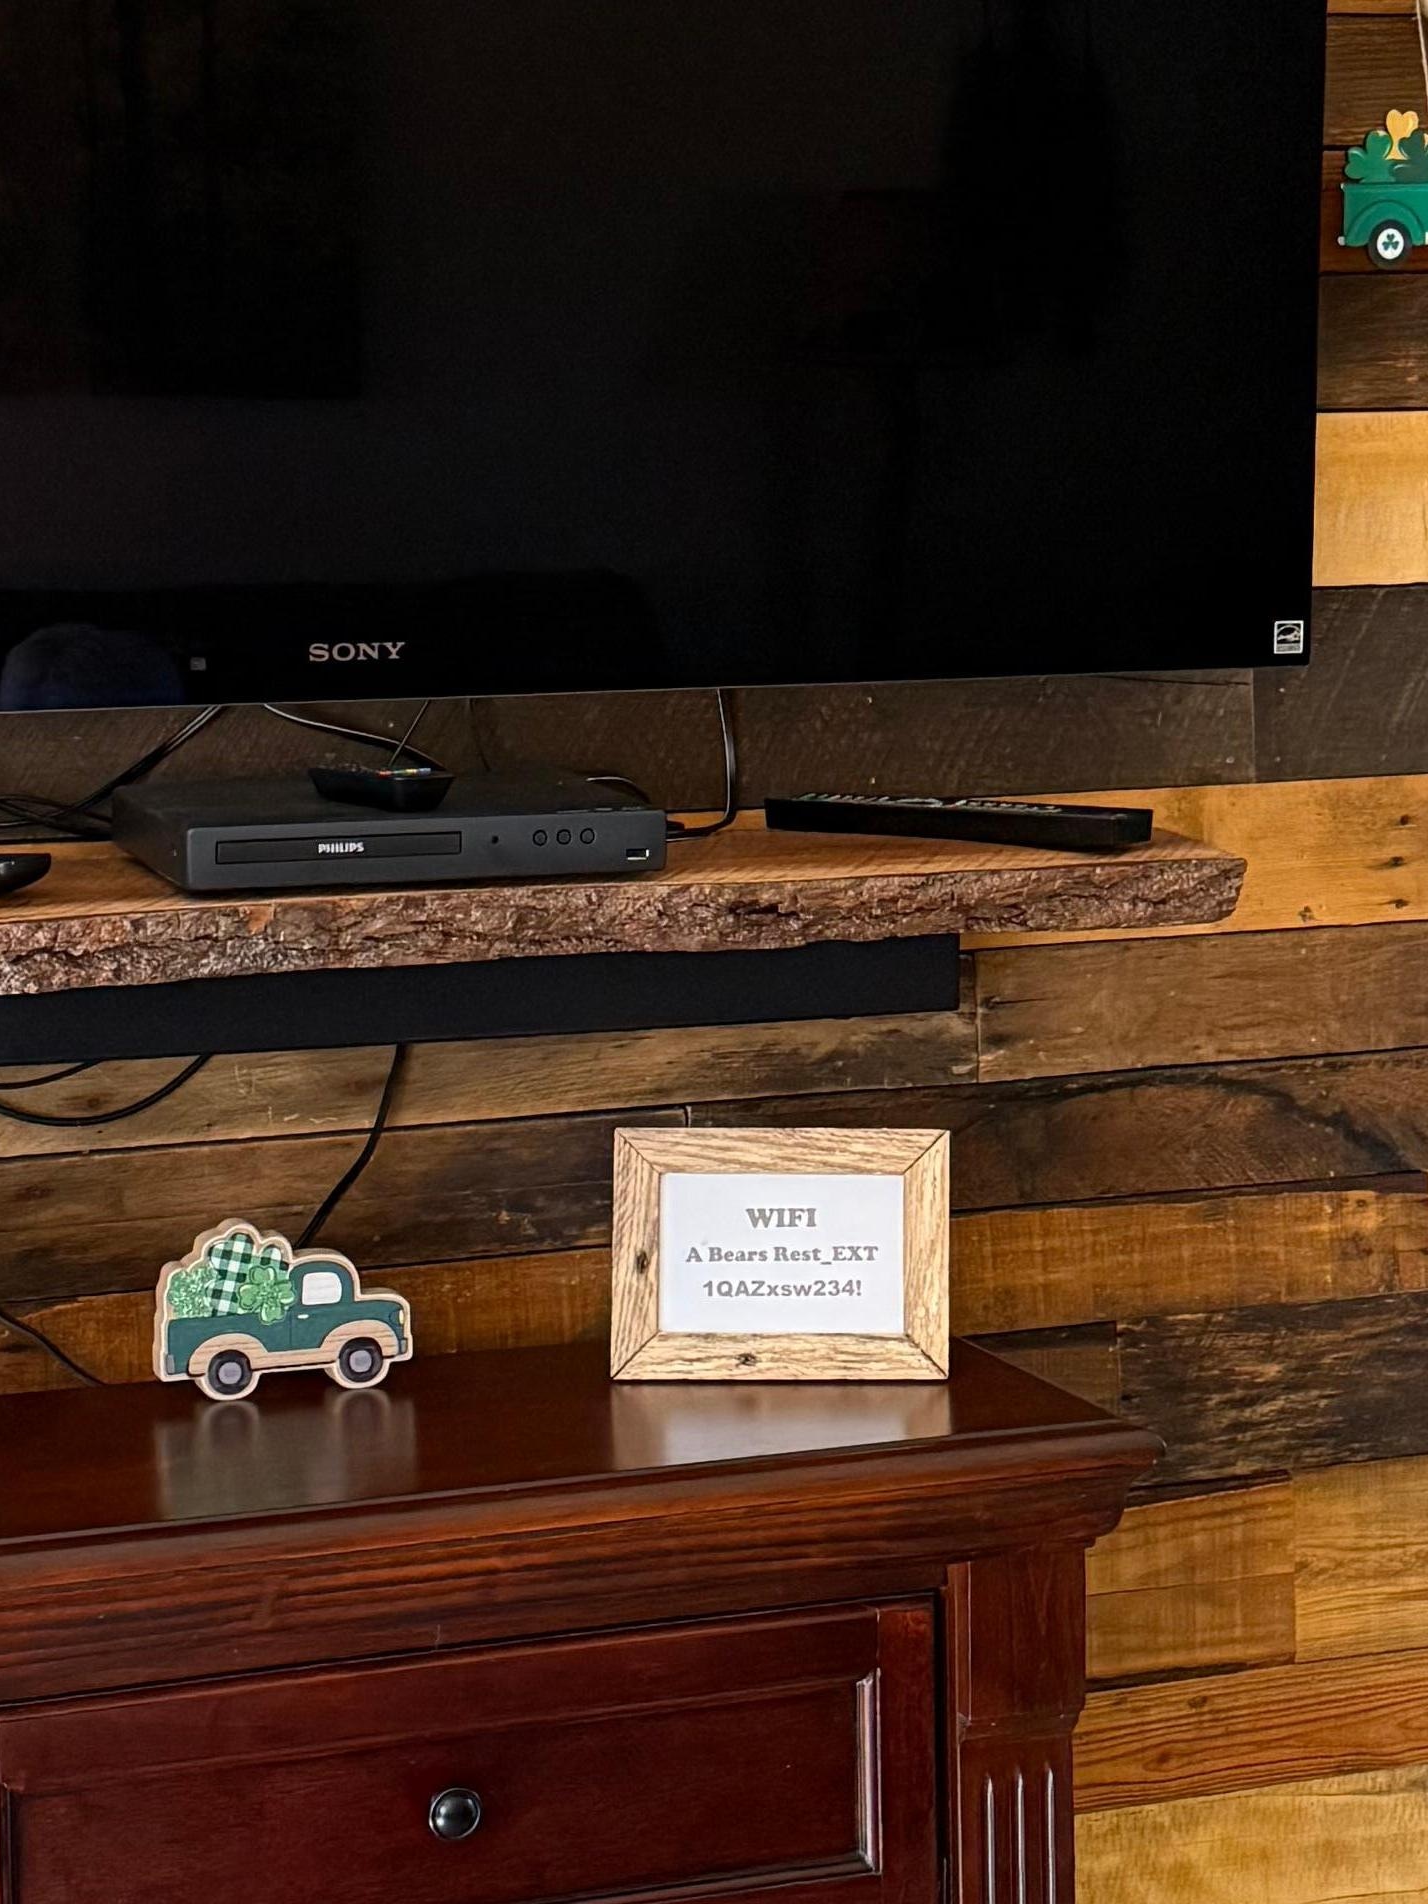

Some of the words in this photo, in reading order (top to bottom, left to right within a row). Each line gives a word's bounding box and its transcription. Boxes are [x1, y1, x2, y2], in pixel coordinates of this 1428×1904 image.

[308, 641, 406, 662] SONY
[318, 841, 365, 854] PHILIPS
[745, 1207, 817, 1229] WIFI
[685, 1246, 703, 1263] A
[708, 1246, 768, 1263] Bears
[773, 1245, 879, 1266] Rest_EXT
[702, 1279, 862, 1298] 1QAZxsw234!
